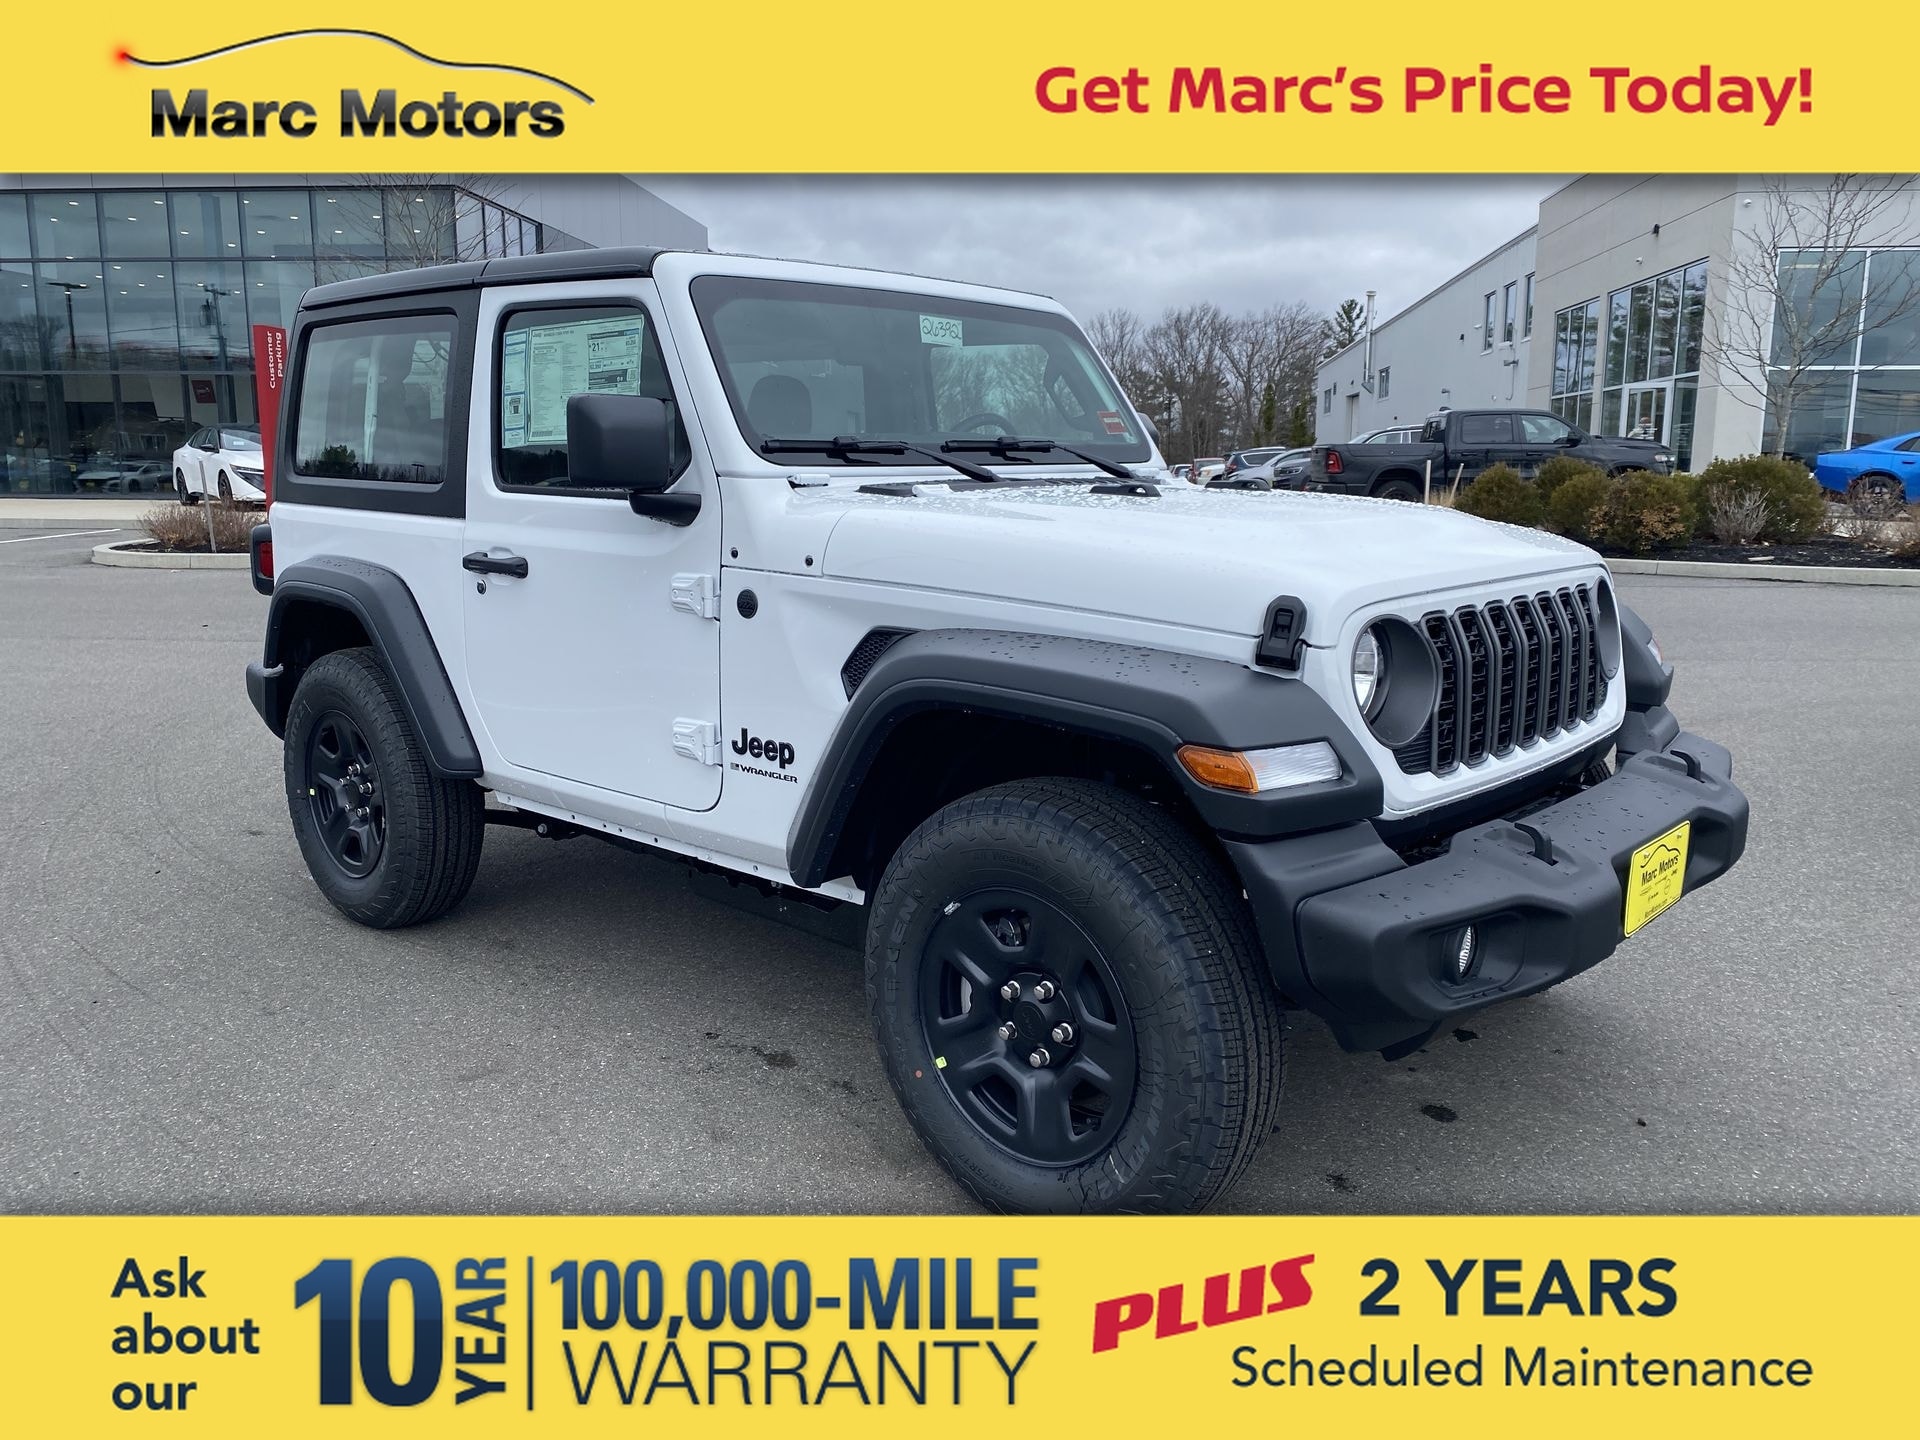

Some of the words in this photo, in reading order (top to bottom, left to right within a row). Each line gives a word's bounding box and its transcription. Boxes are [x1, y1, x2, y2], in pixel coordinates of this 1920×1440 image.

[921, 317, 962, 341] 26392
[267, 331, 276, 389] Customer
[731, 727, 795, 769] Jeep
[740, 764, 798, 784] WRANGLER
[1641, 868, 1658, 887] Marc
[1660, 855, 1679, 875] Motors
